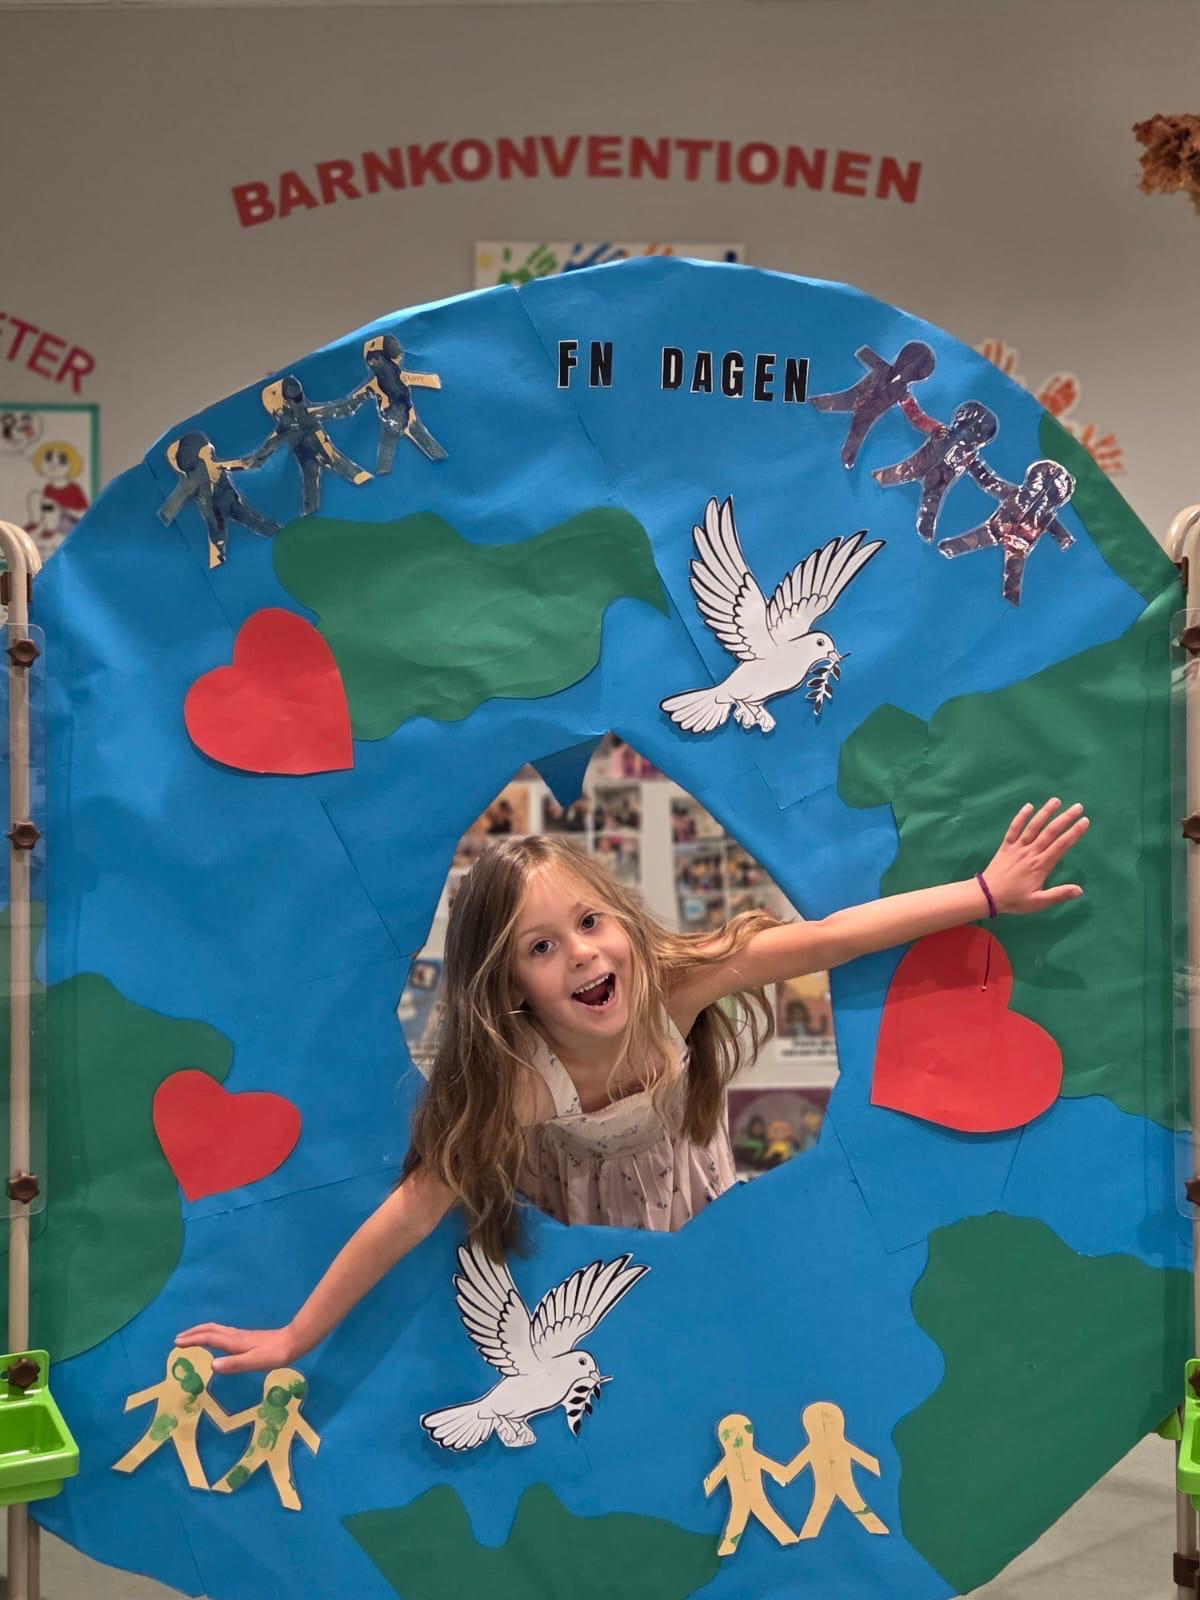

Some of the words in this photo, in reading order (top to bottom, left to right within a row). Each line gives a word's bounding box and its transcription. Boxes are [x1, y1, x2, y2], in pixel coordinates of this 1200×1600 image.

[232, 134, 922, 228] BARNKONVENTIONEN
[0, 311, 96, 394] TER
[558, 341, 613, 387] FN
[661, 347, 808, 402] DAGEN
